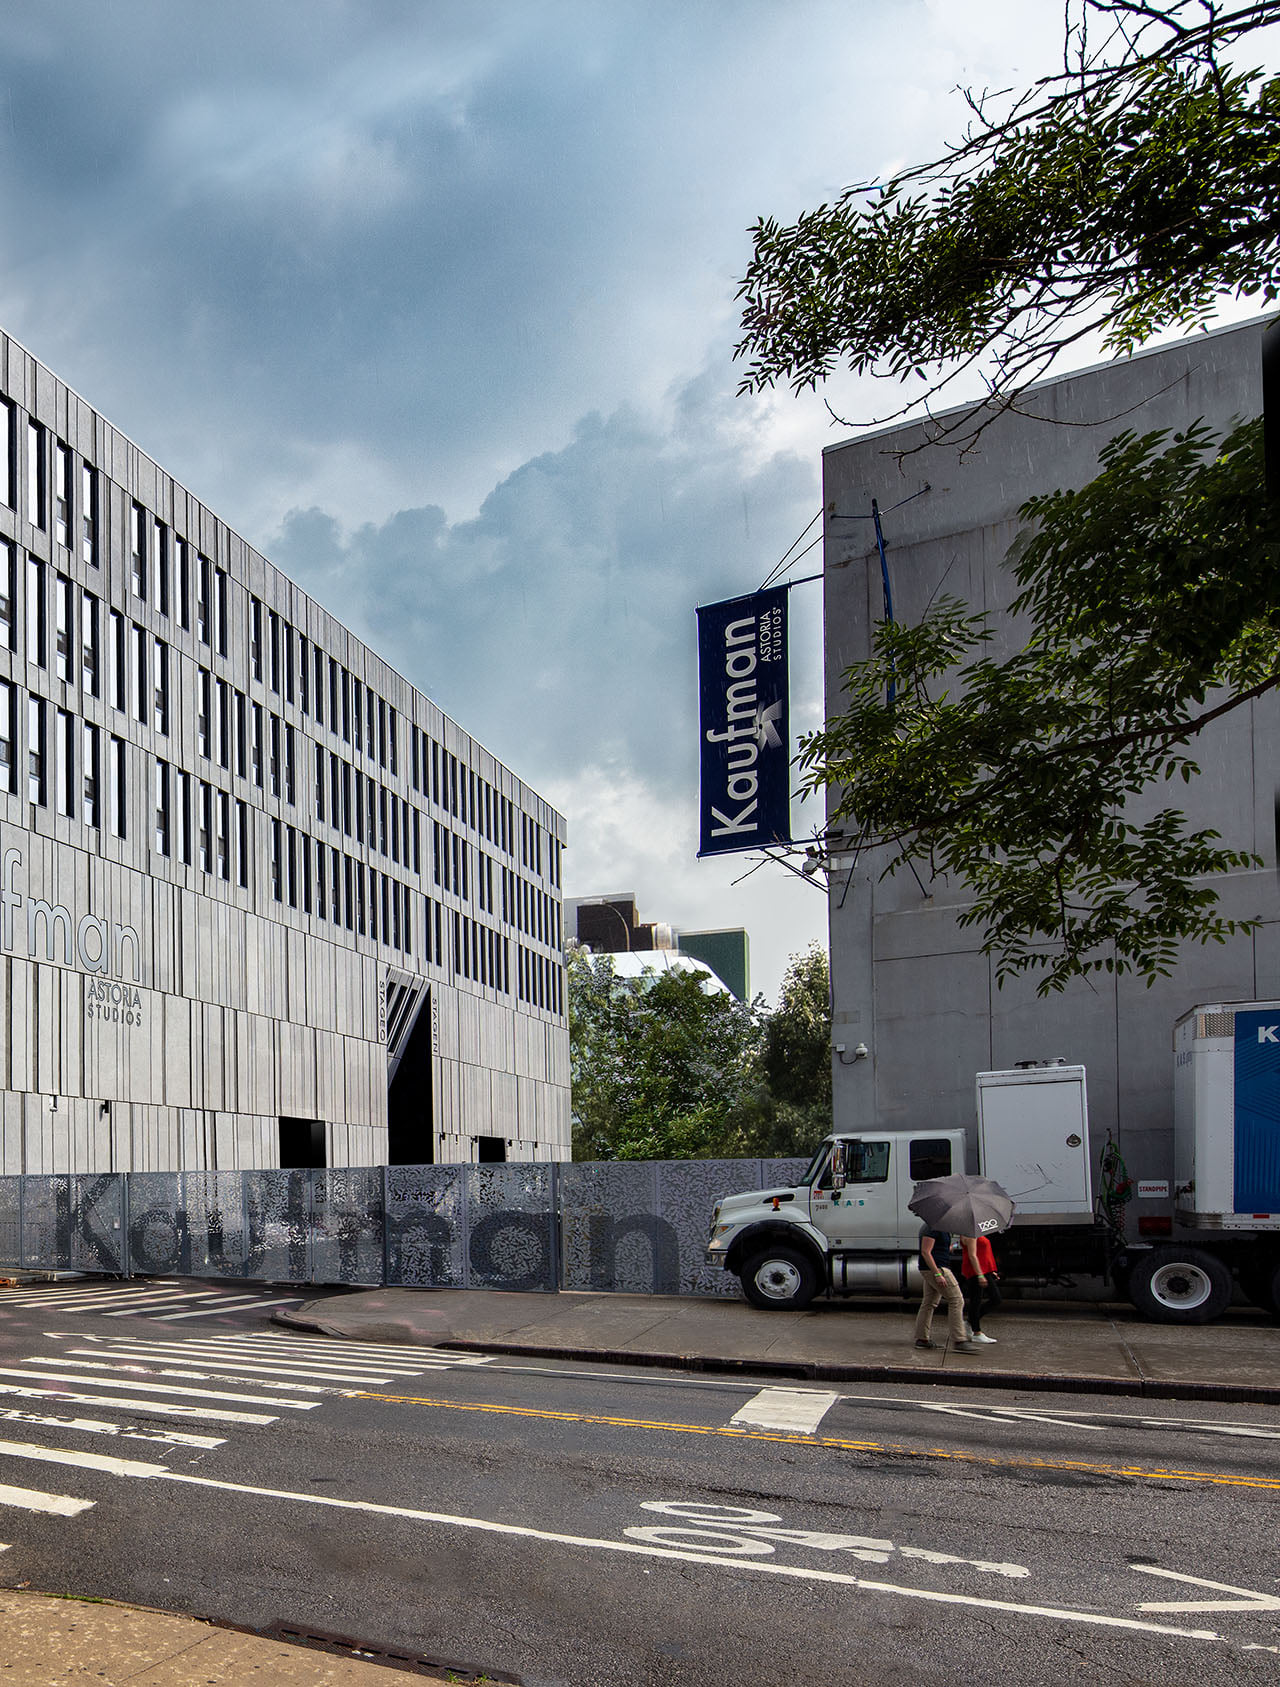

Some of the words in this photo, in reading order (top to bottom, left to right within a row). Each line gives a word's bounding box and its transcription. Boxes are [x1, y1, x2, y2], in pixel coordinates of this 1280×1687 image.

[760, 610, 771, 663] ASTORIA
[773, 607, 782, 661] STUDIOS
[706, 615, 759, 838] Kaufman
[87, 976, 142, 1010] ASTORIA
[87, 1002, 142, 1028] STUDIOS
[56, 1170, 680, 1294] Kaufman
